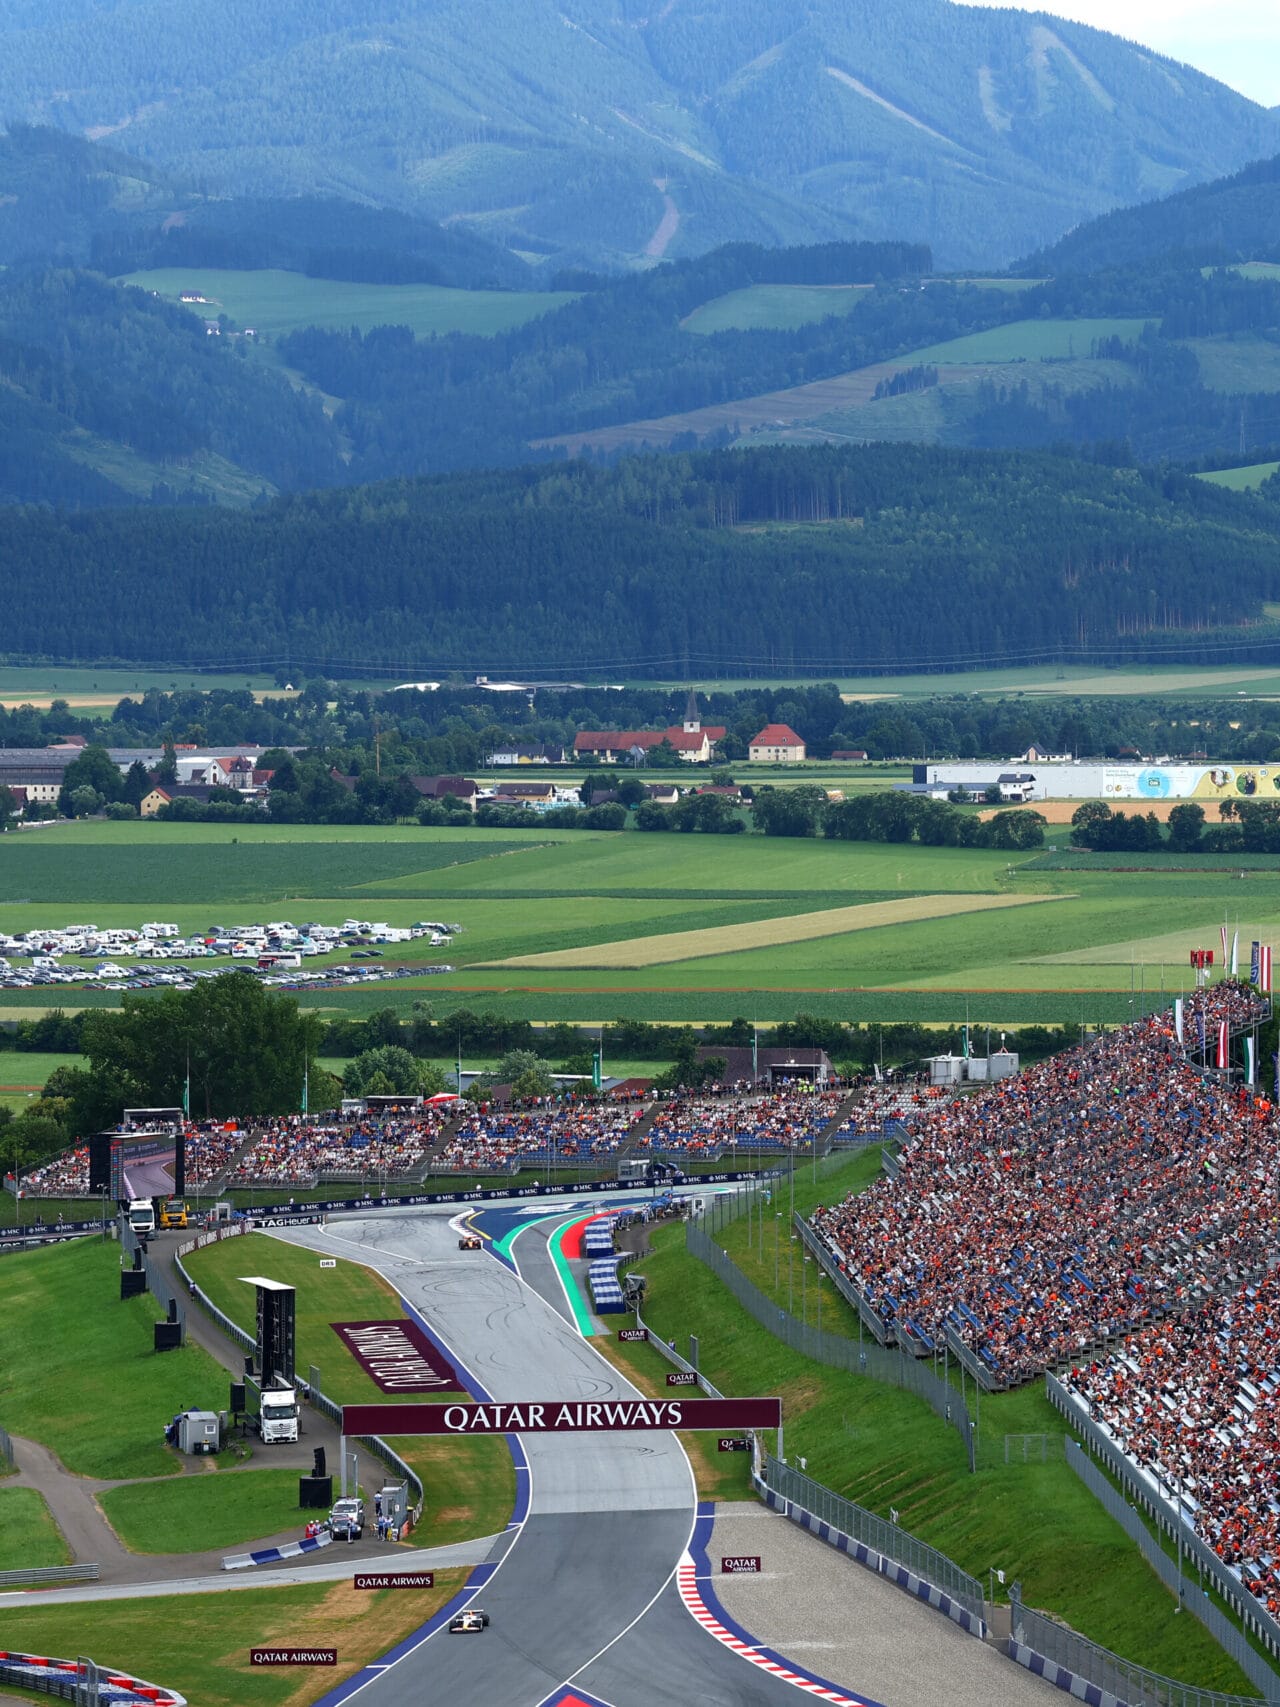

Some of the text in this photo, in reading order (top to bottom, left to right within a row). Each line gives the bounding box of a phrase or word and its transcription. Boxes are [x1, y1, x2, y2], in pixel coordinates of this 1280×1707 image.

[621, 1330, 645, 1338] QATAR
[669, 1374, 694, 1382] QATAR
[444, 1402, 682, 1432] QATAR AIRWAYS
[725, 1559, 756, 1568] QATAR
[357, 1576, 430, 1588] QATAR AIRWAYS
[254, 1652, 334, 1663] QATAR AIRWAYS
